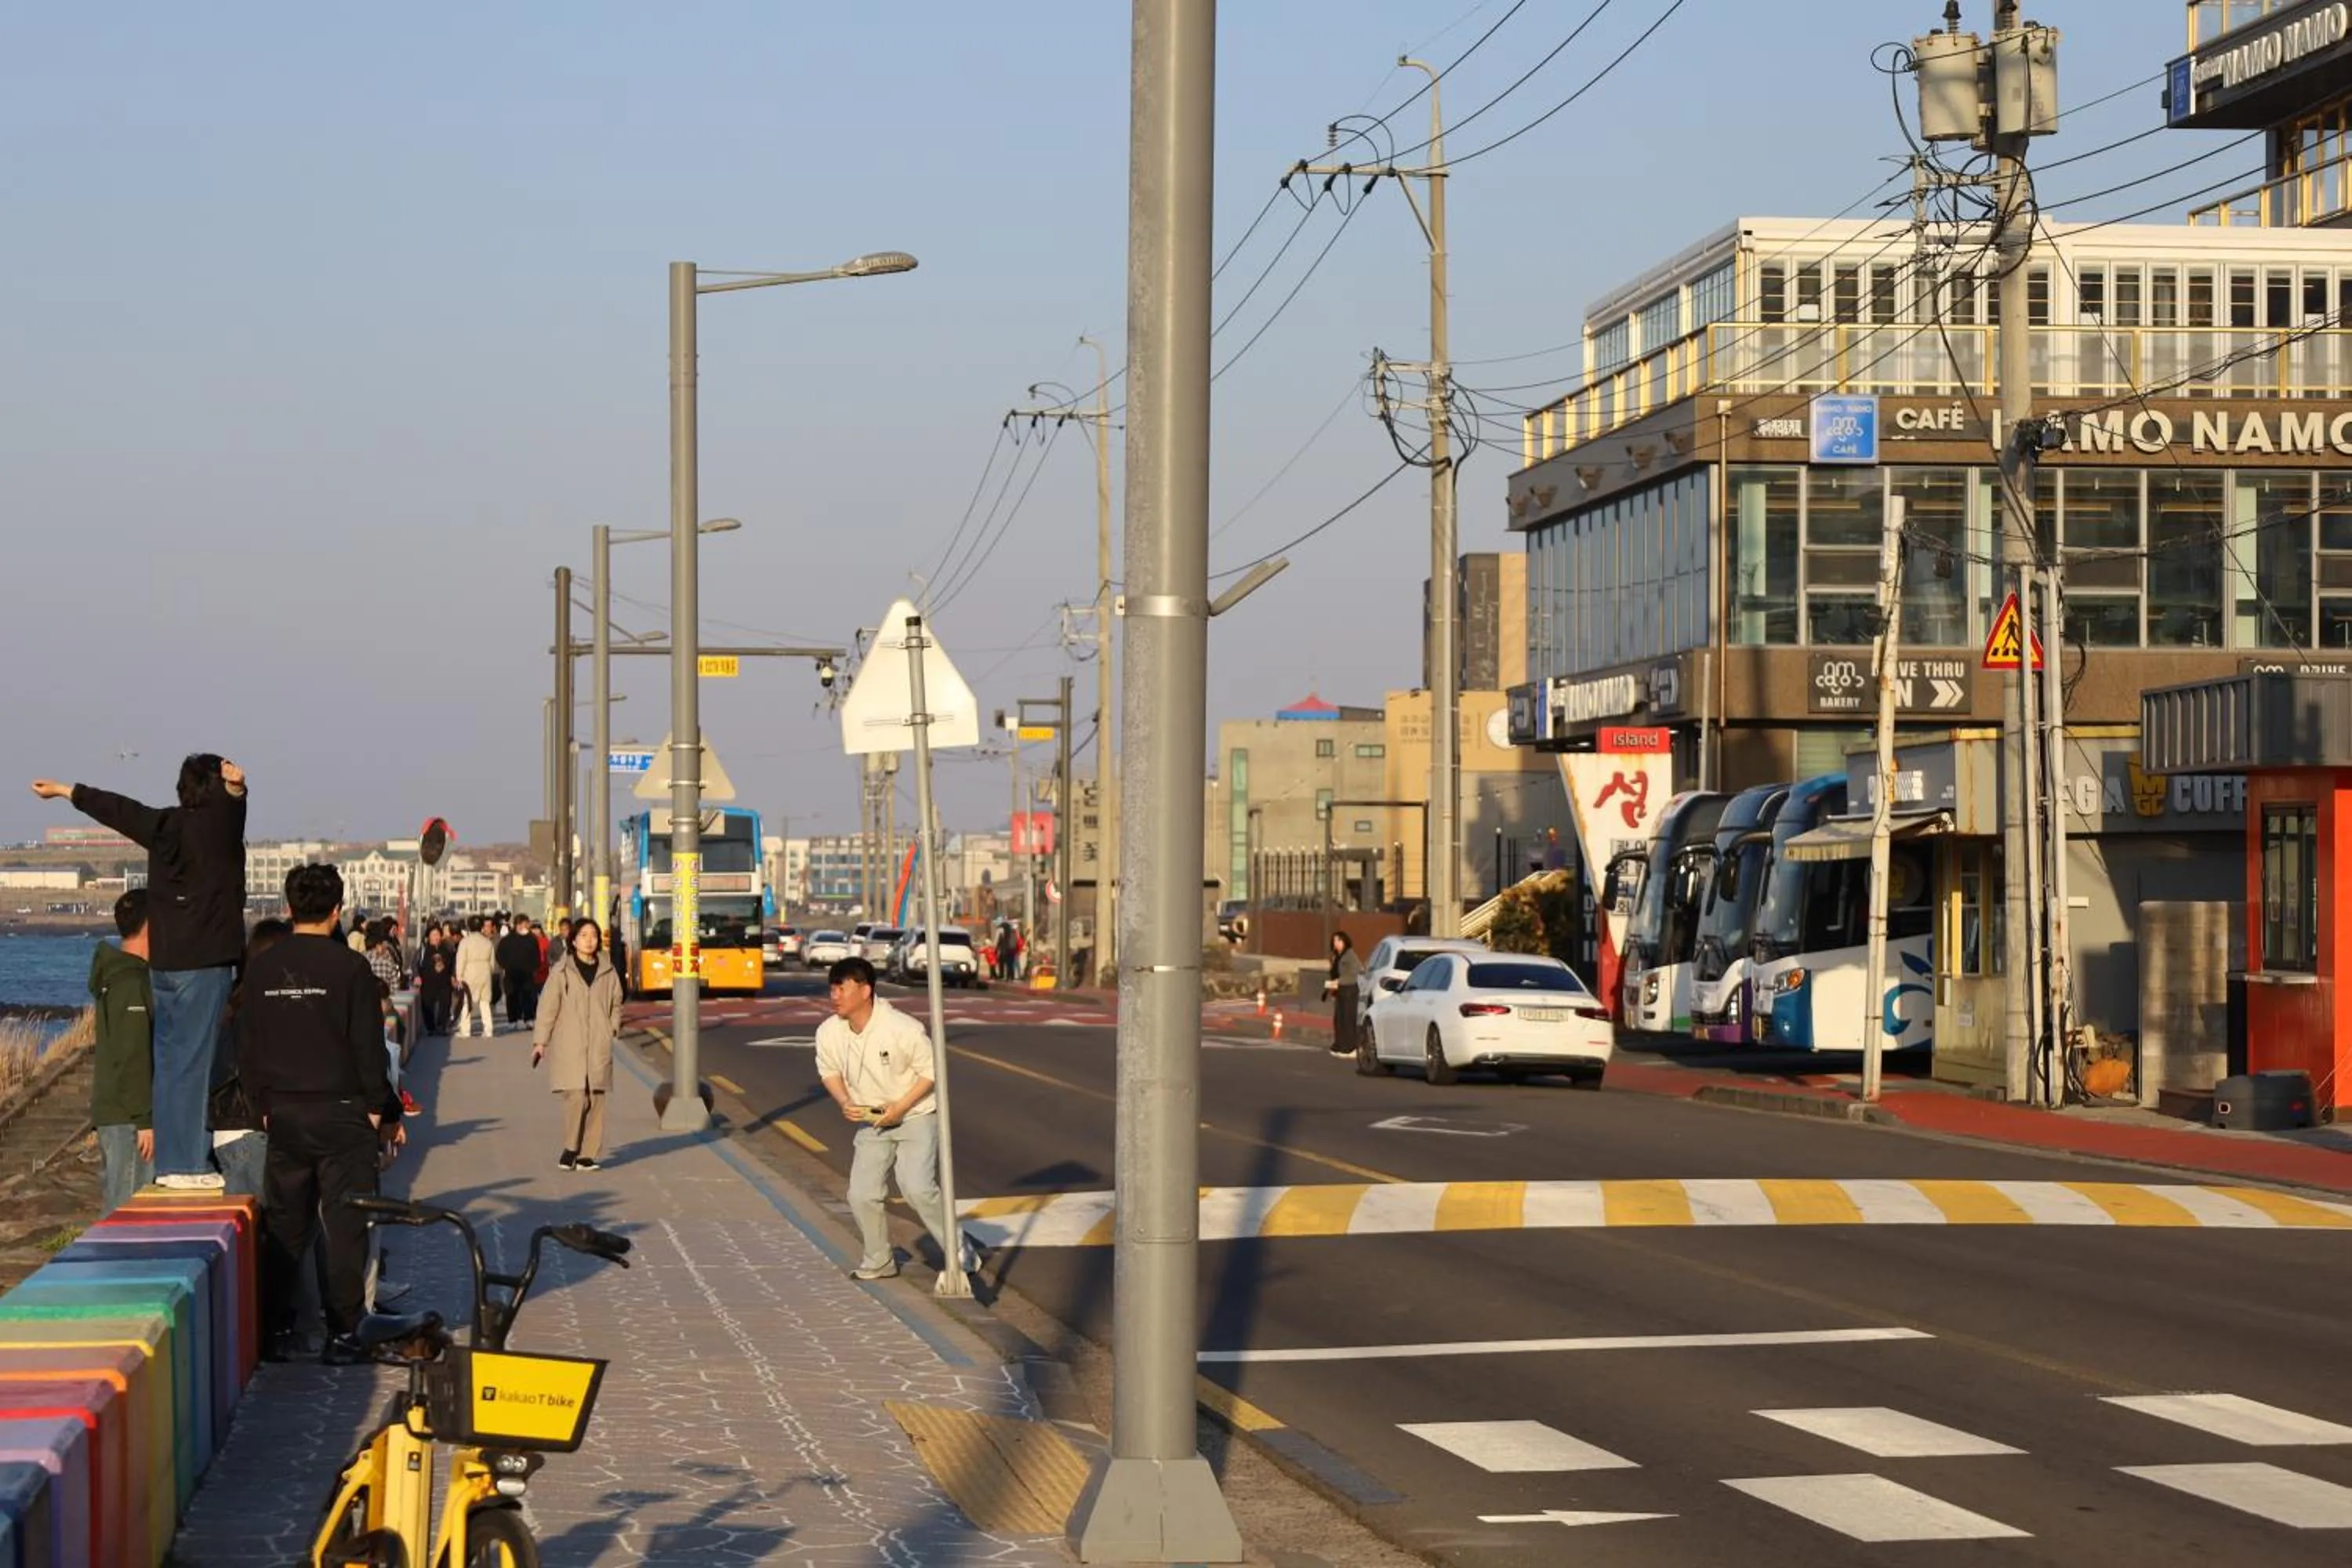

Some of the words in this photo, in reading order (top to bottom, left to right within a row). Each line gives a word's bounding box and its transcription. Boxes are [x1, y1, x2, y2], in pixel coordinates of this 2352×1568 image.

[1923, 661, 1965, 678] THRU
[1593, 770, 1649, 829] 섬
[499, 1388, 537, 1405] kakao
[547, 1394, 575, 1409] bike
